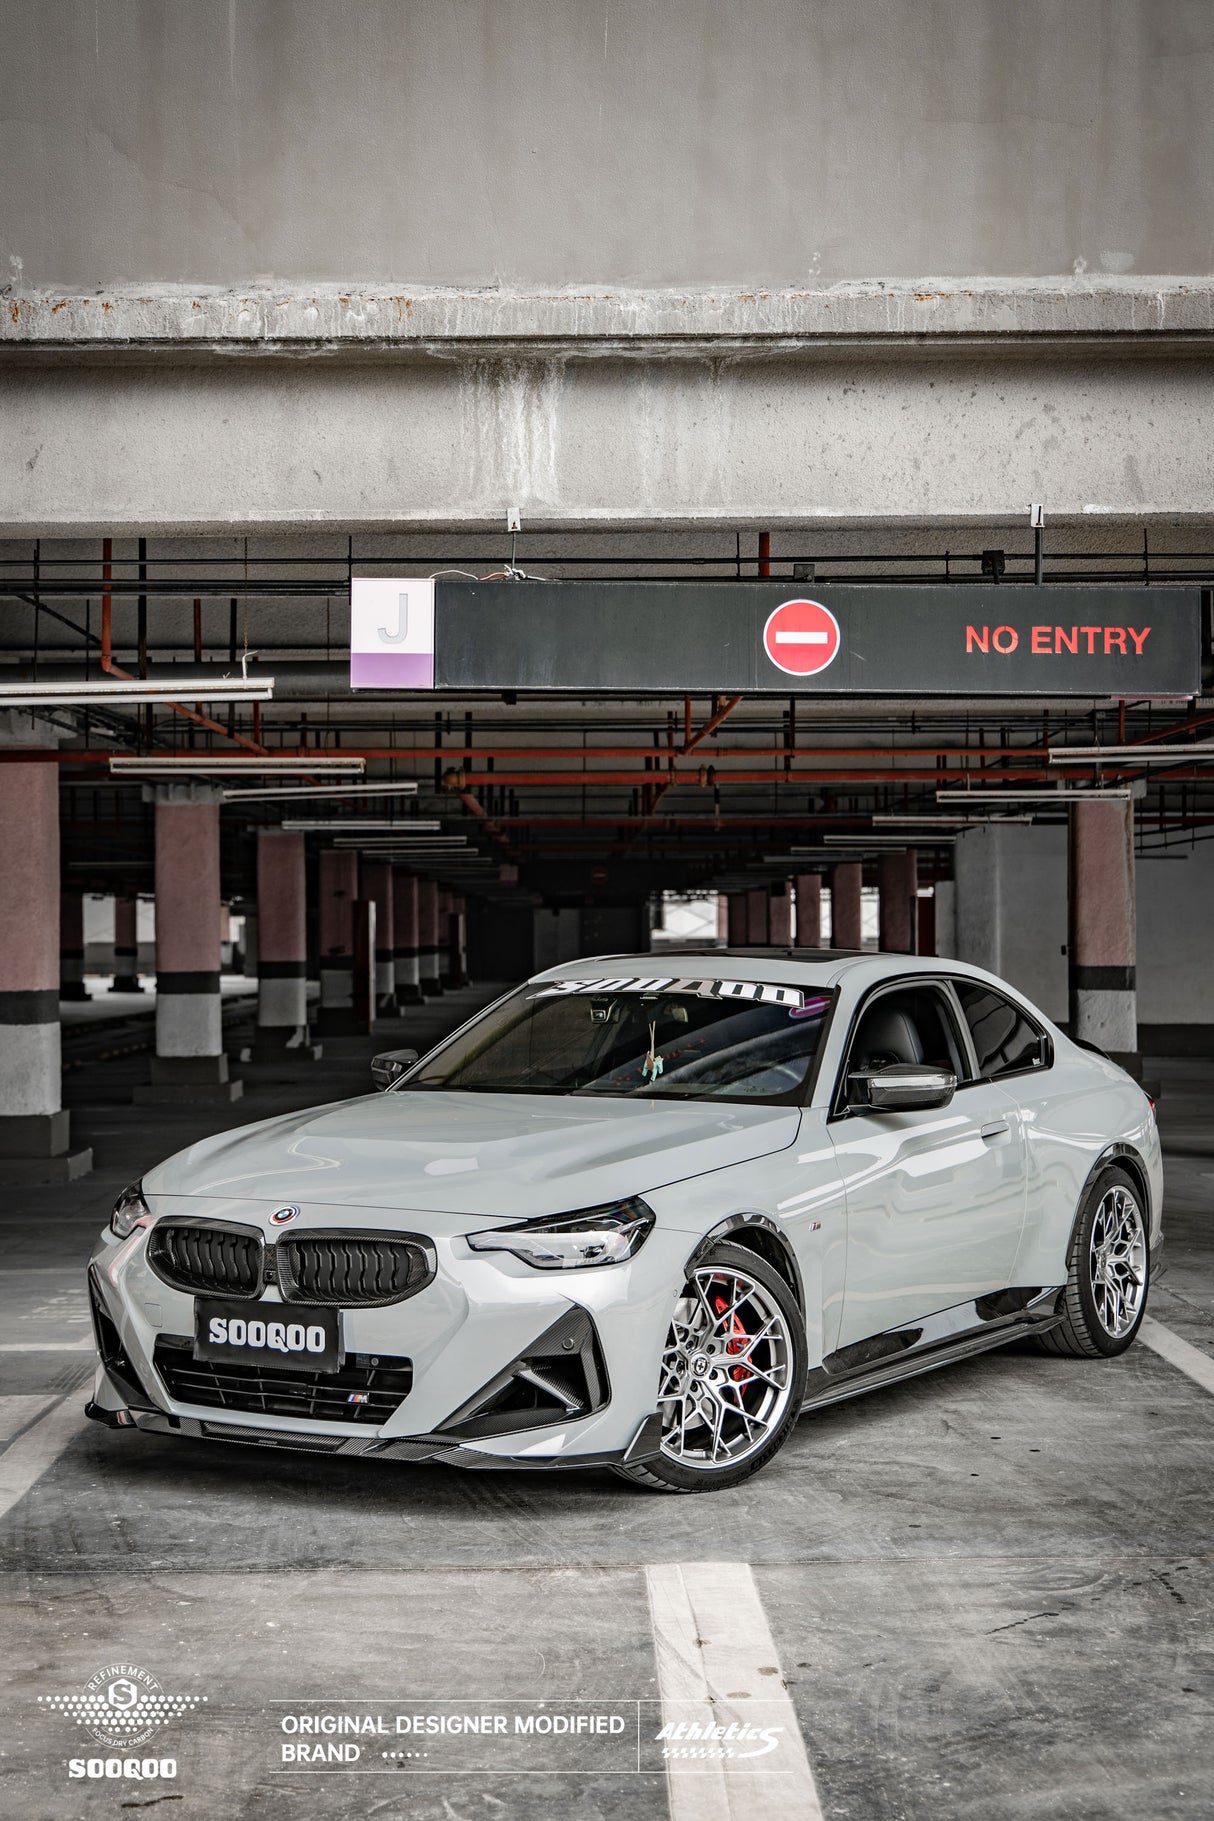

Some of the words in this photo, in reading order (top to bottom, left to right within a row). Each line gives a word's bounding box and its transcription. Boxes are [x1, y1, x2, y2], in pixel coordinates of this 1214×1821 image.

[377, 592, 408, 645] J
[965, 625, 1019, 654] NO
[1031, 625, 1152, 655] ENTRY
[208, 1316, 327, 1354] SOOQOO
